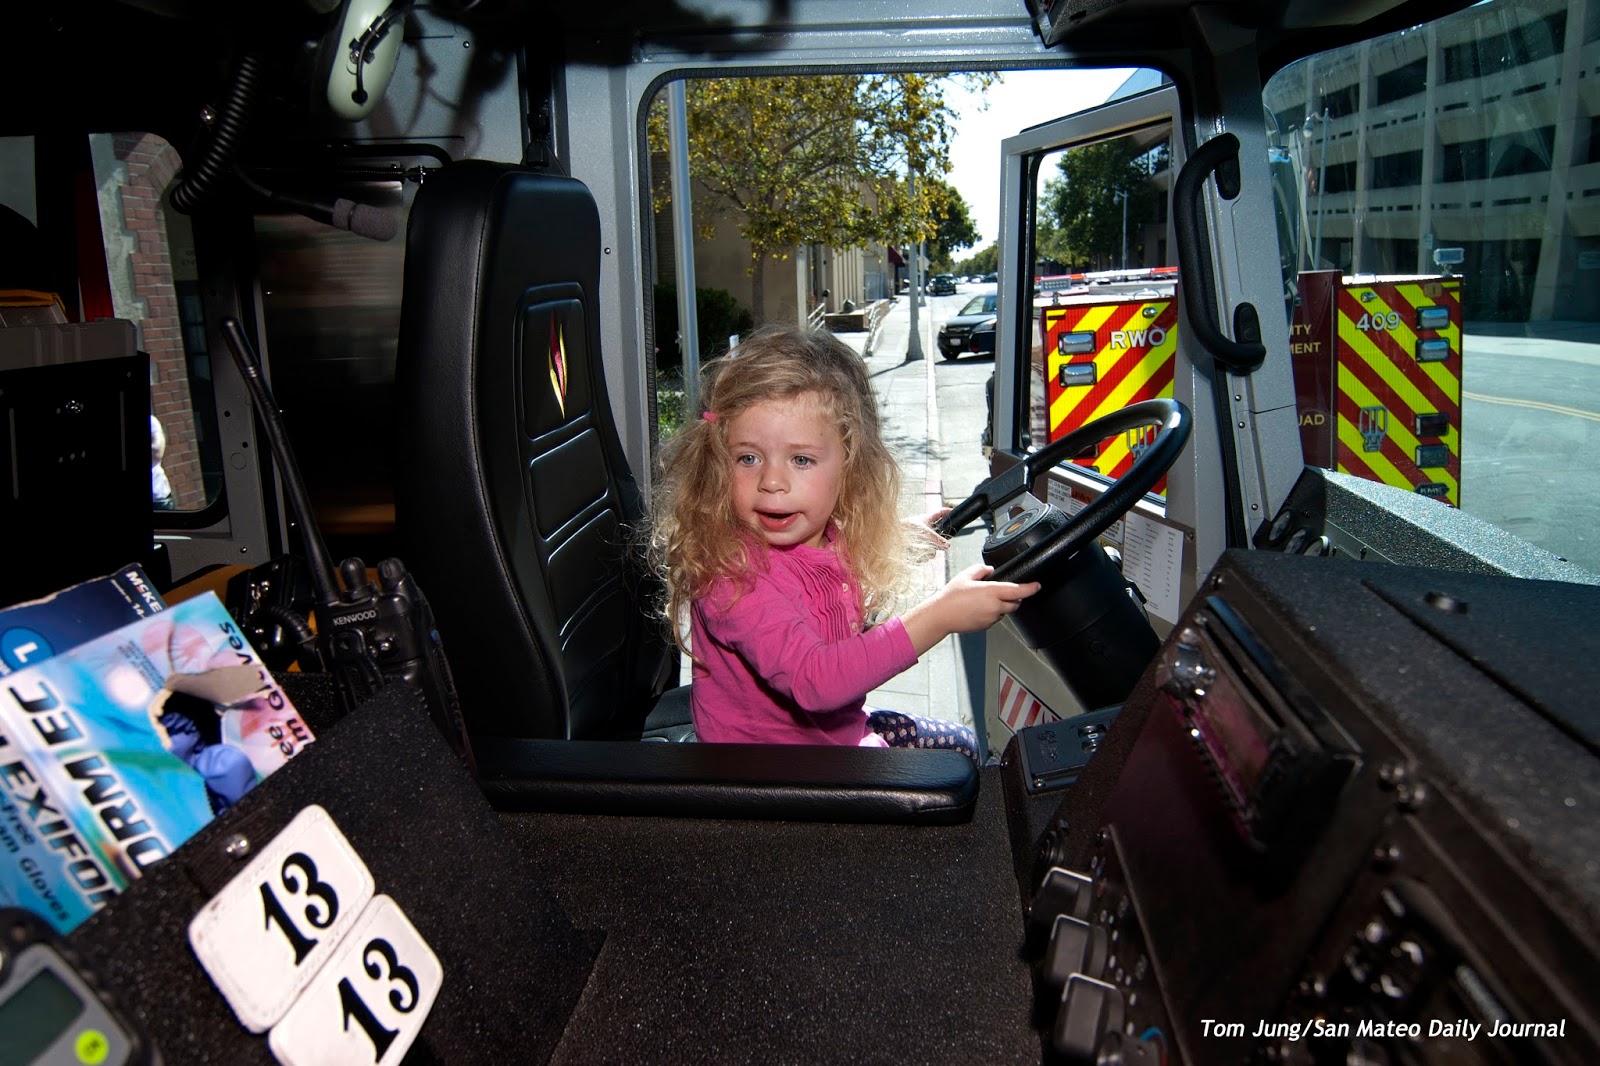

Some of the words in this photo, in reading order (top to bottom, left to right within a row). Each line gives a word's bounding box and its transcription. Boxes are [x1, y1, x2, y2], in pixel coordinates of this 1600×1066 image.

[1110, 328, 1166, 349] RWO
[1356, 311, 1401, 331] 409
[333, 610, 377, 626] KENWOOD
[13, 642, 40, 663] L
[8, 681, 84, 746] EC
[20, 857, 70, 921] Gloves
[259, 851, 340, 967] 13
[338, 938, 420, 1065] 13
